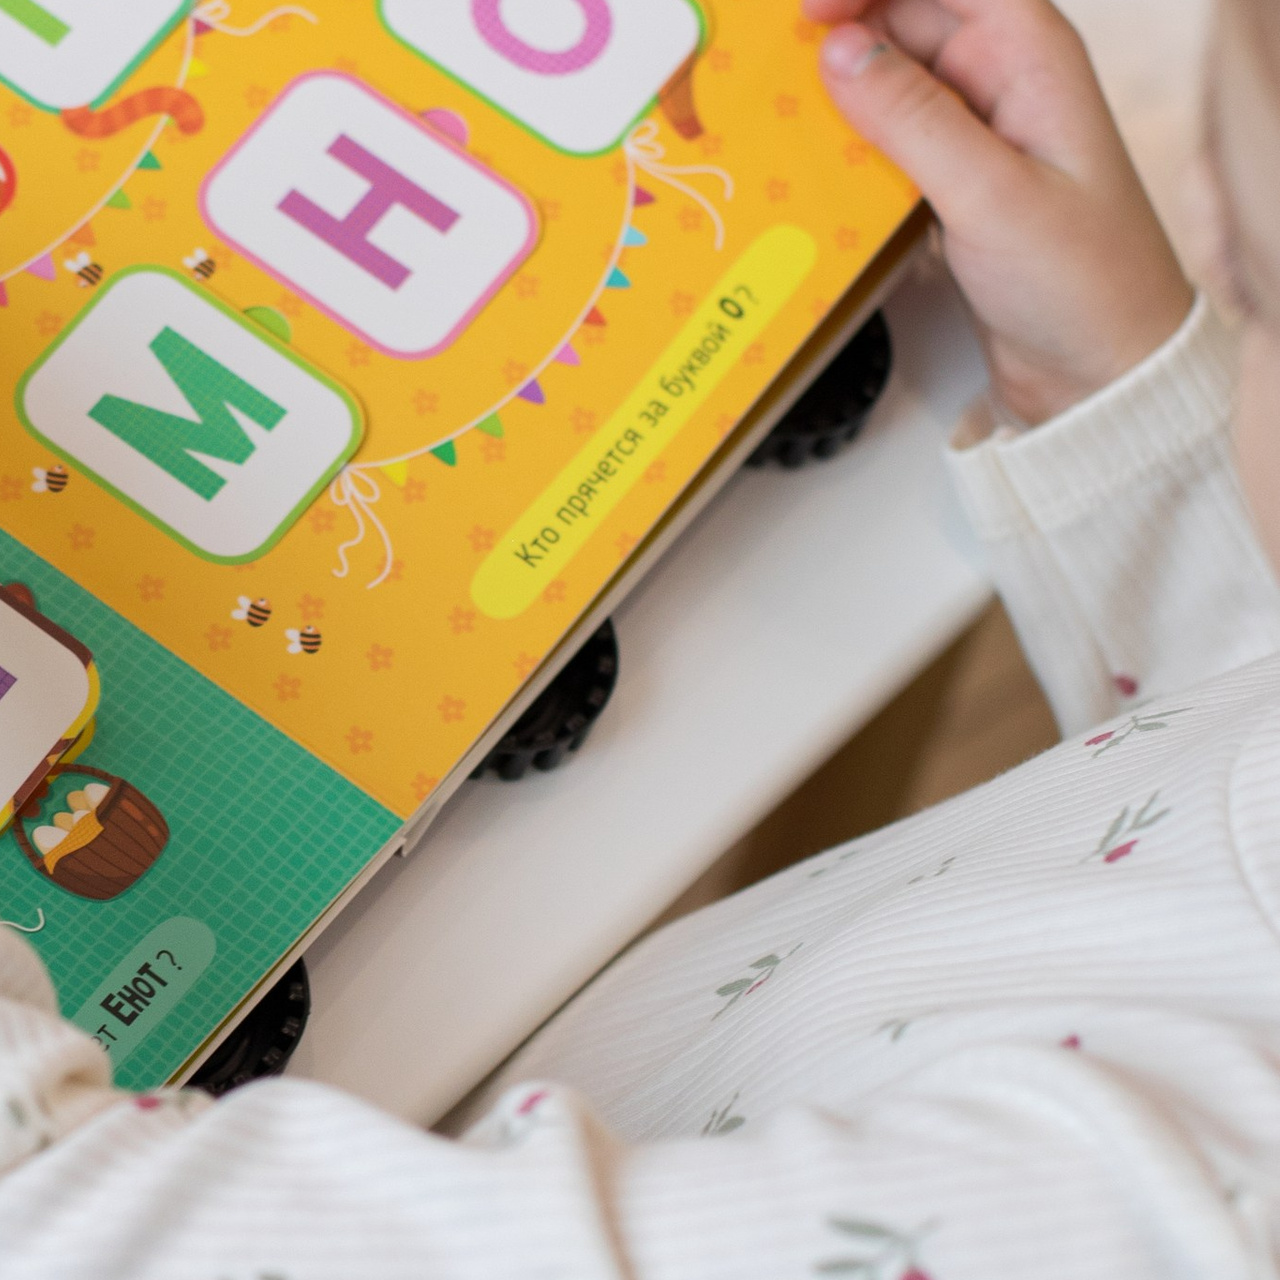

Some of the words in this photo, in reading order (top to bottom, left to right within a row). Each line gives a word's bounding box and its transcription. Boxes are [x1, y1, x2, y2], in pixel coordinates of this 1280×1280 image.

[276, 132, 460, 291] Н
[88, 325, 288, 501] М
[513, 525, 560, 568] Кто
[556, 427, 645, 526] прячется
[639, 399, 669, 428] за
[660, 321, 731, 398] буквой
